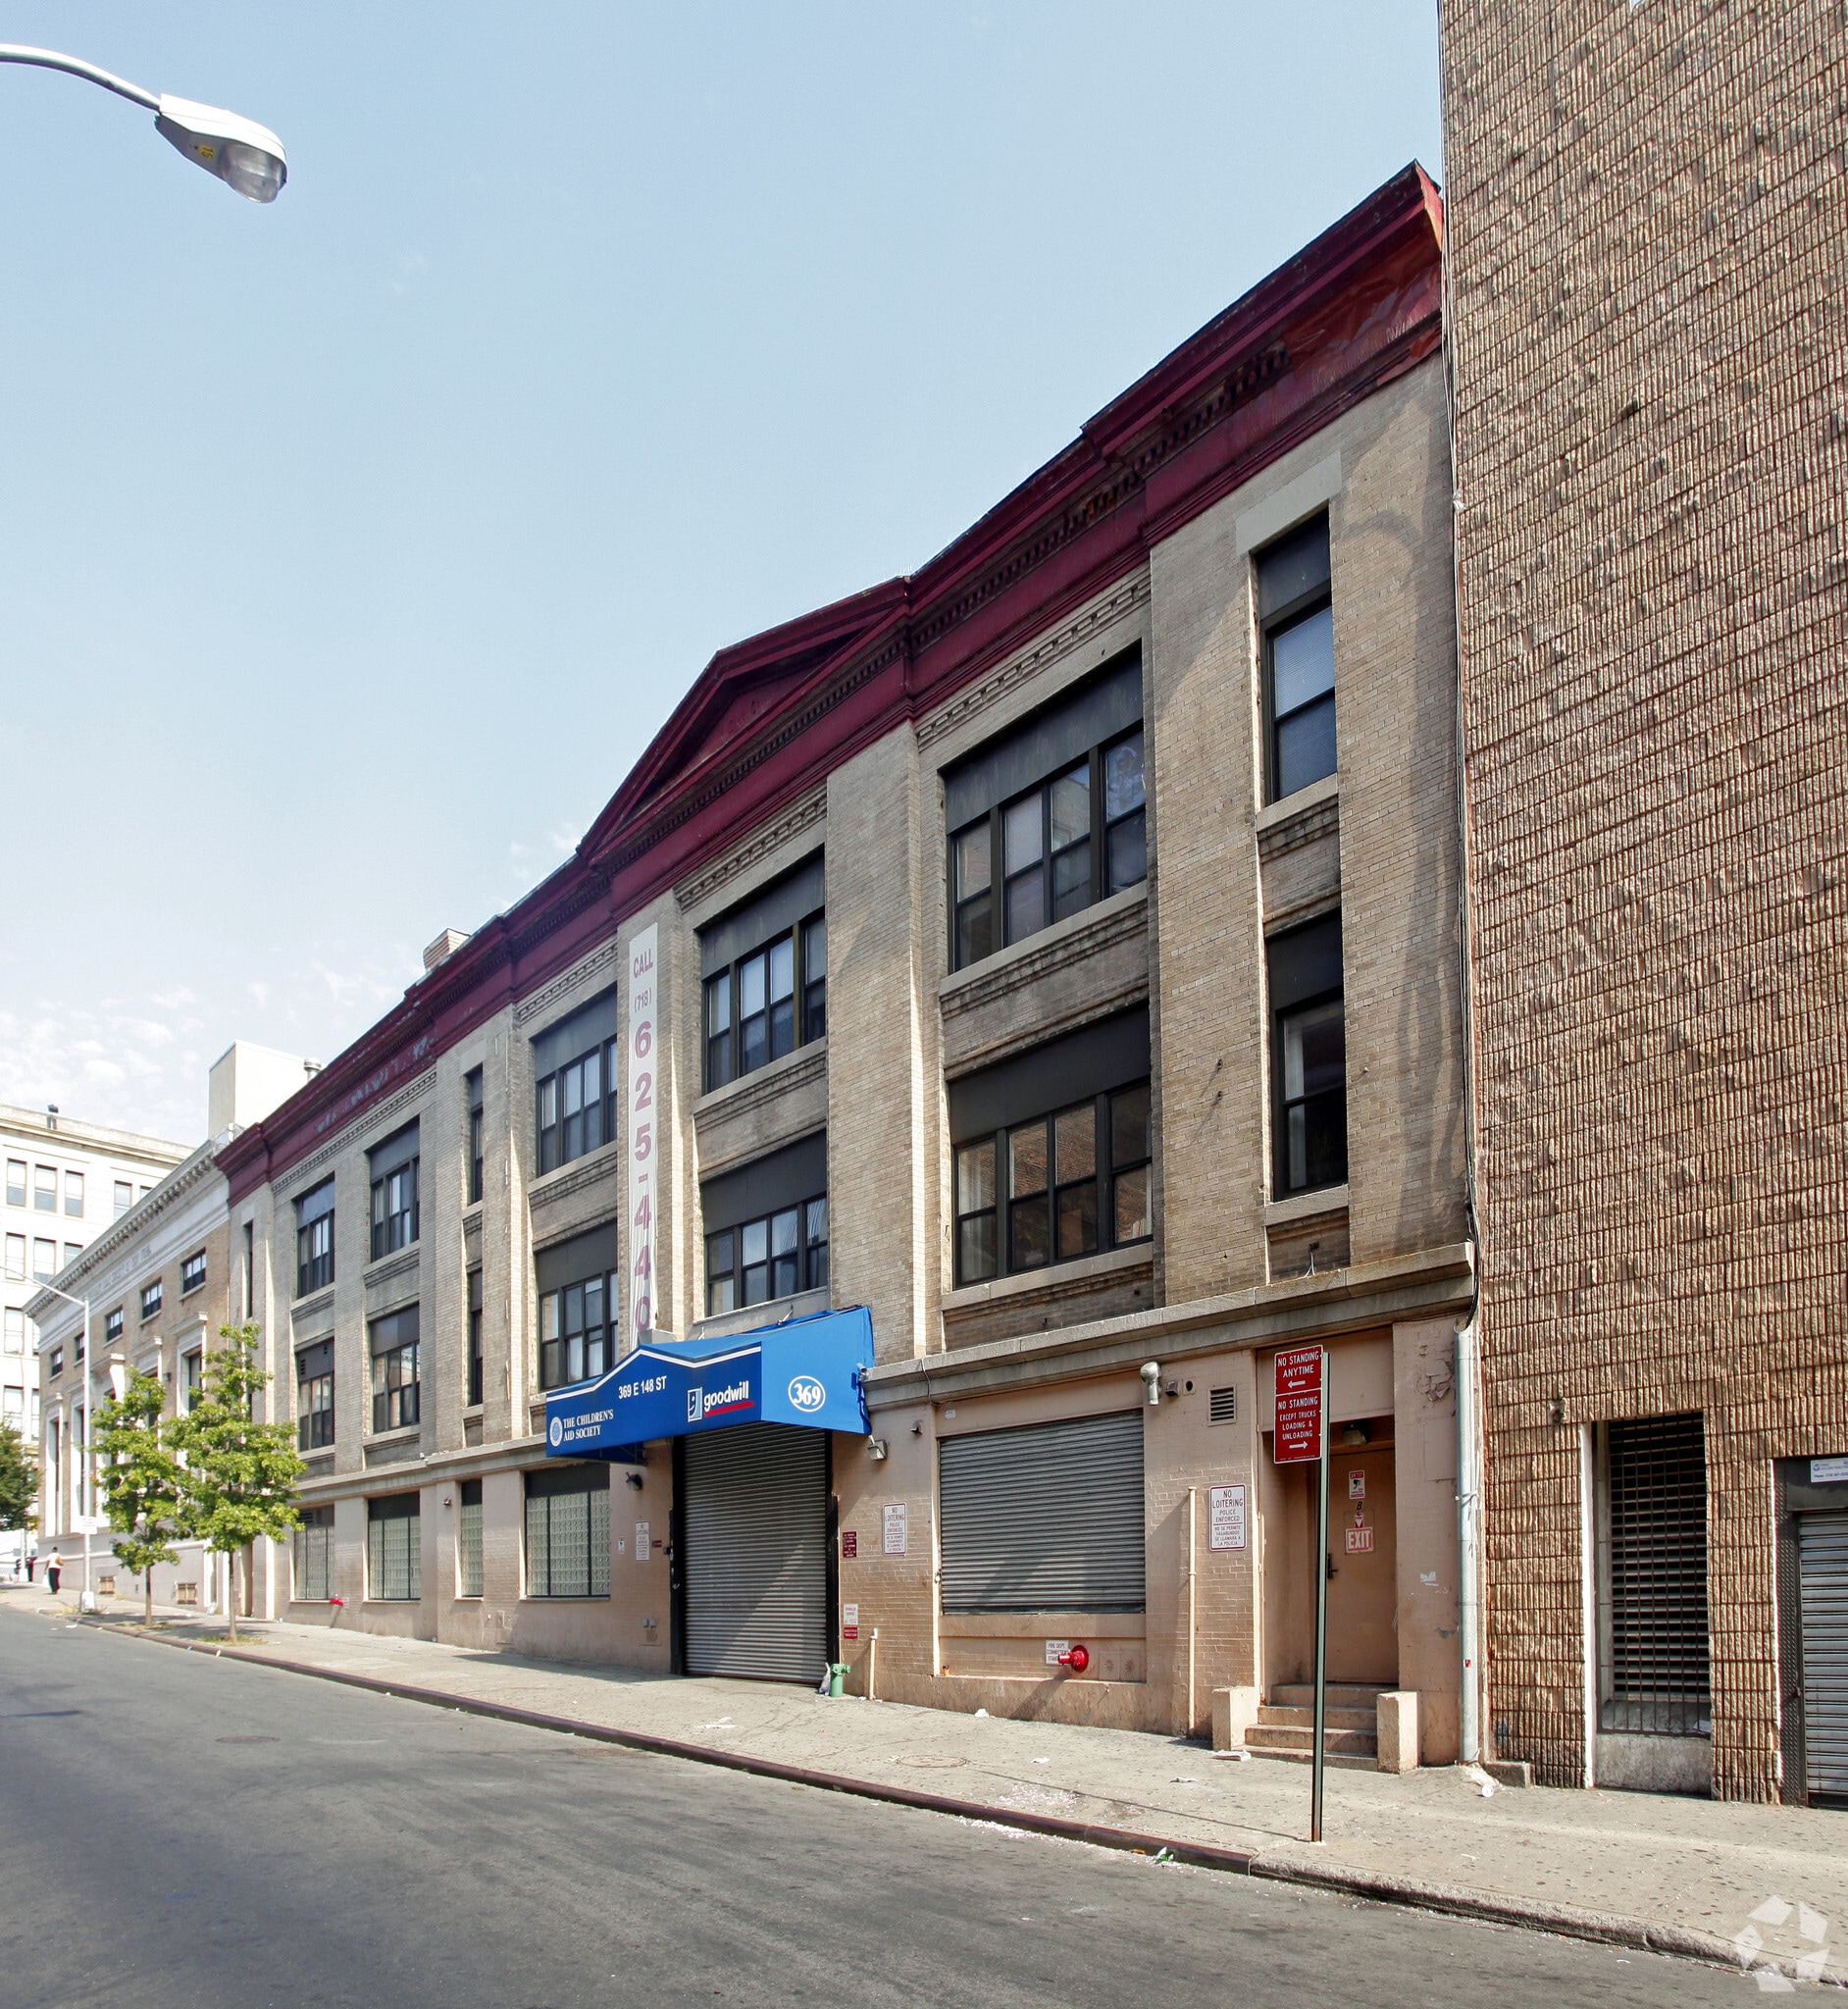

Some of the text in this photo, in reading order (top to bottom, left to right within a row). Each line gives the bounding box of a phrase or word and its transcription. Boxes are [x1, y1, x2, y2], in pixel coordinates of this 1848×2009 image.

[634, 949, 653, 979] CALL
[635, 987, 652, 1013] (718)
[1278, 1351, 1319, 1367] NO STANDING
[1283, 1365, 1314, 1378] ANYTIME
[618, 1375, 667, 1399] 369 E 148 ST
[794, 1383, 821, 1406] 369
[703, 1380, 749, 1413] goodwill
[1278, 1396, 1318, 1411] NO STANDING
[563, 1409, 614, 1429] THE CHILDREN'S
[1279, 1410, 1316, 1422] EXCEPT TRUCKS
[563, 1424, 601, 1442] AID SOCIETY
[1282, 1421, 1306, 1431] LOADING
[1282, 1430, 1313, 1440] UNLOADING
[1223, 1489, 1232, 1499] NO
[1212, 1498, 1243, 1509] LOITERING
[1348, 1530, 1370, 1549] EXIT
